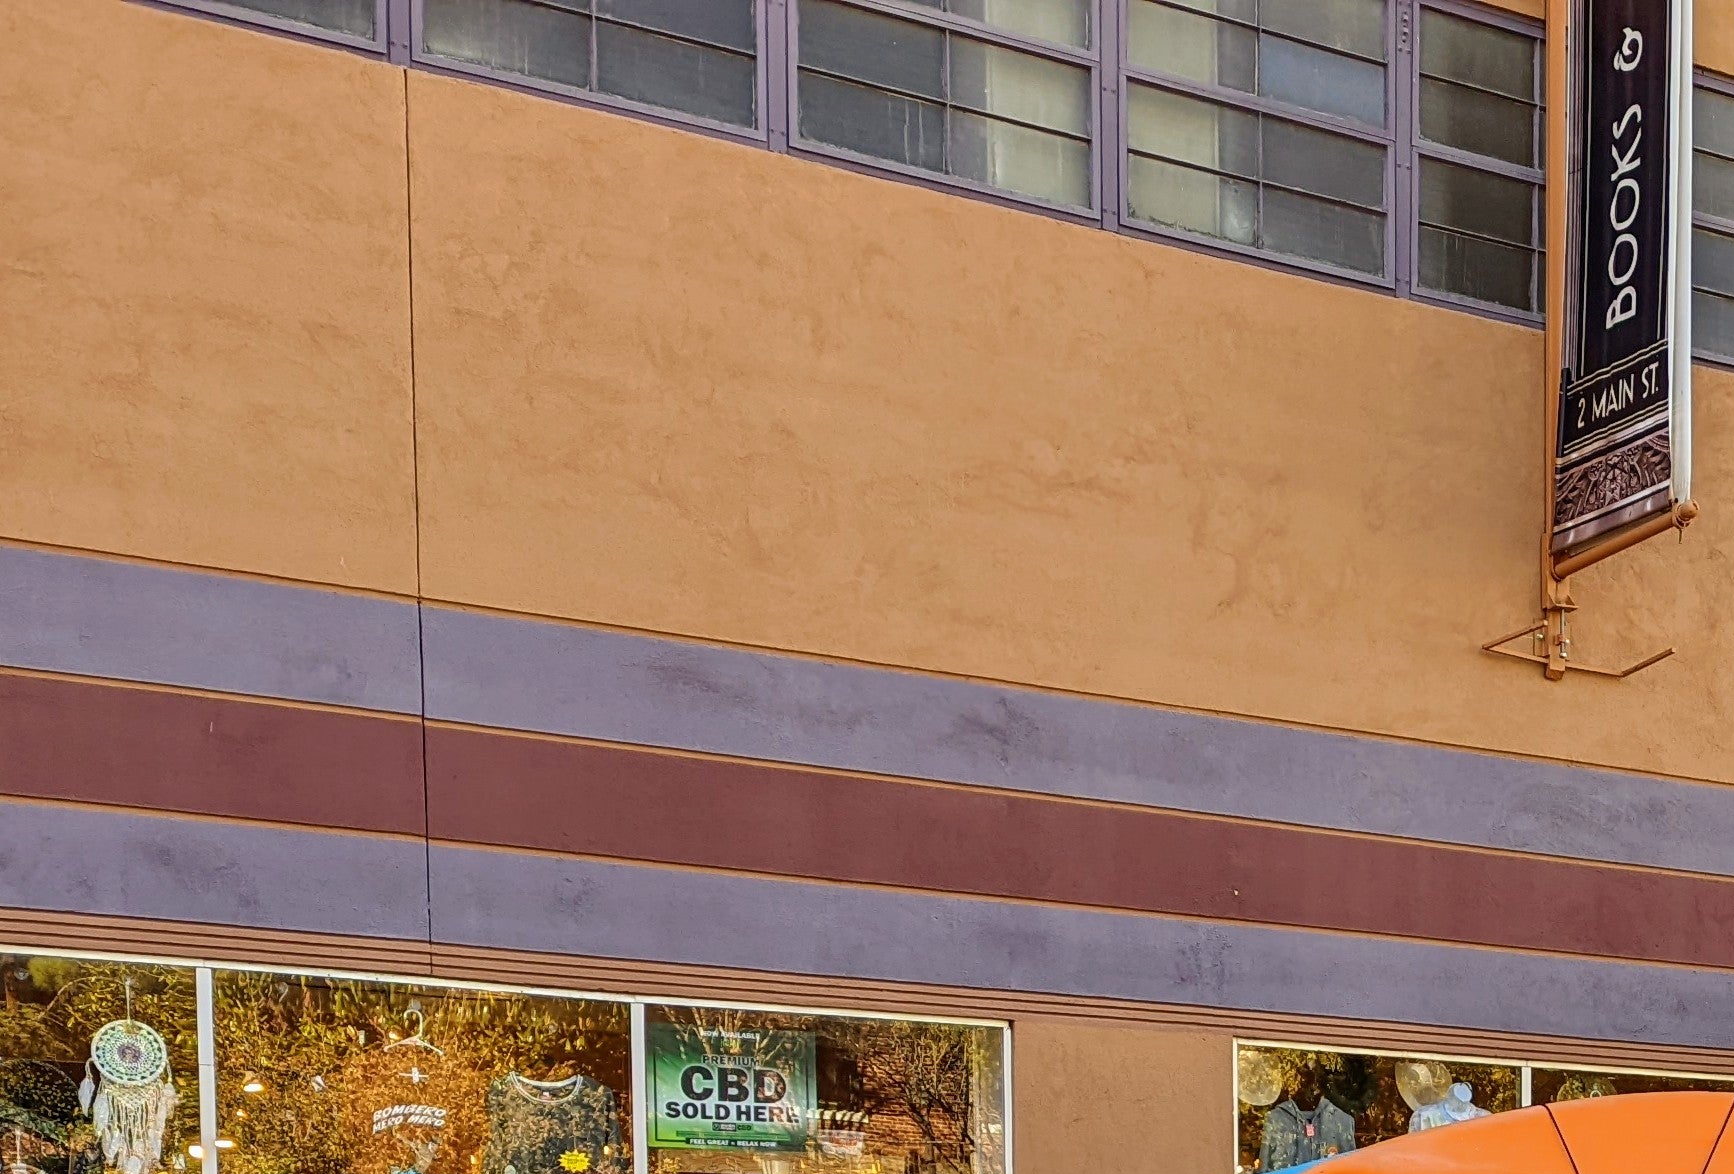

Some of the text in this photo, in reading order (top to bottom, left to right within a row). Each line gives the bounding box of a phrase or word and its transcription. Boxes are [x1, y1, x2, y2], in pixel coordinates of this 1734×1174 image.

[1605, 27, 1643, 329] BOOKS &
[1577, 361, 1660, 429] 2 MAIN ST.
[702, 1054, 761, 1068] PREMIUM
[680, 1065, 787, 1104] CBD
[664, 1101, 800, 1124] SOLD HERE
